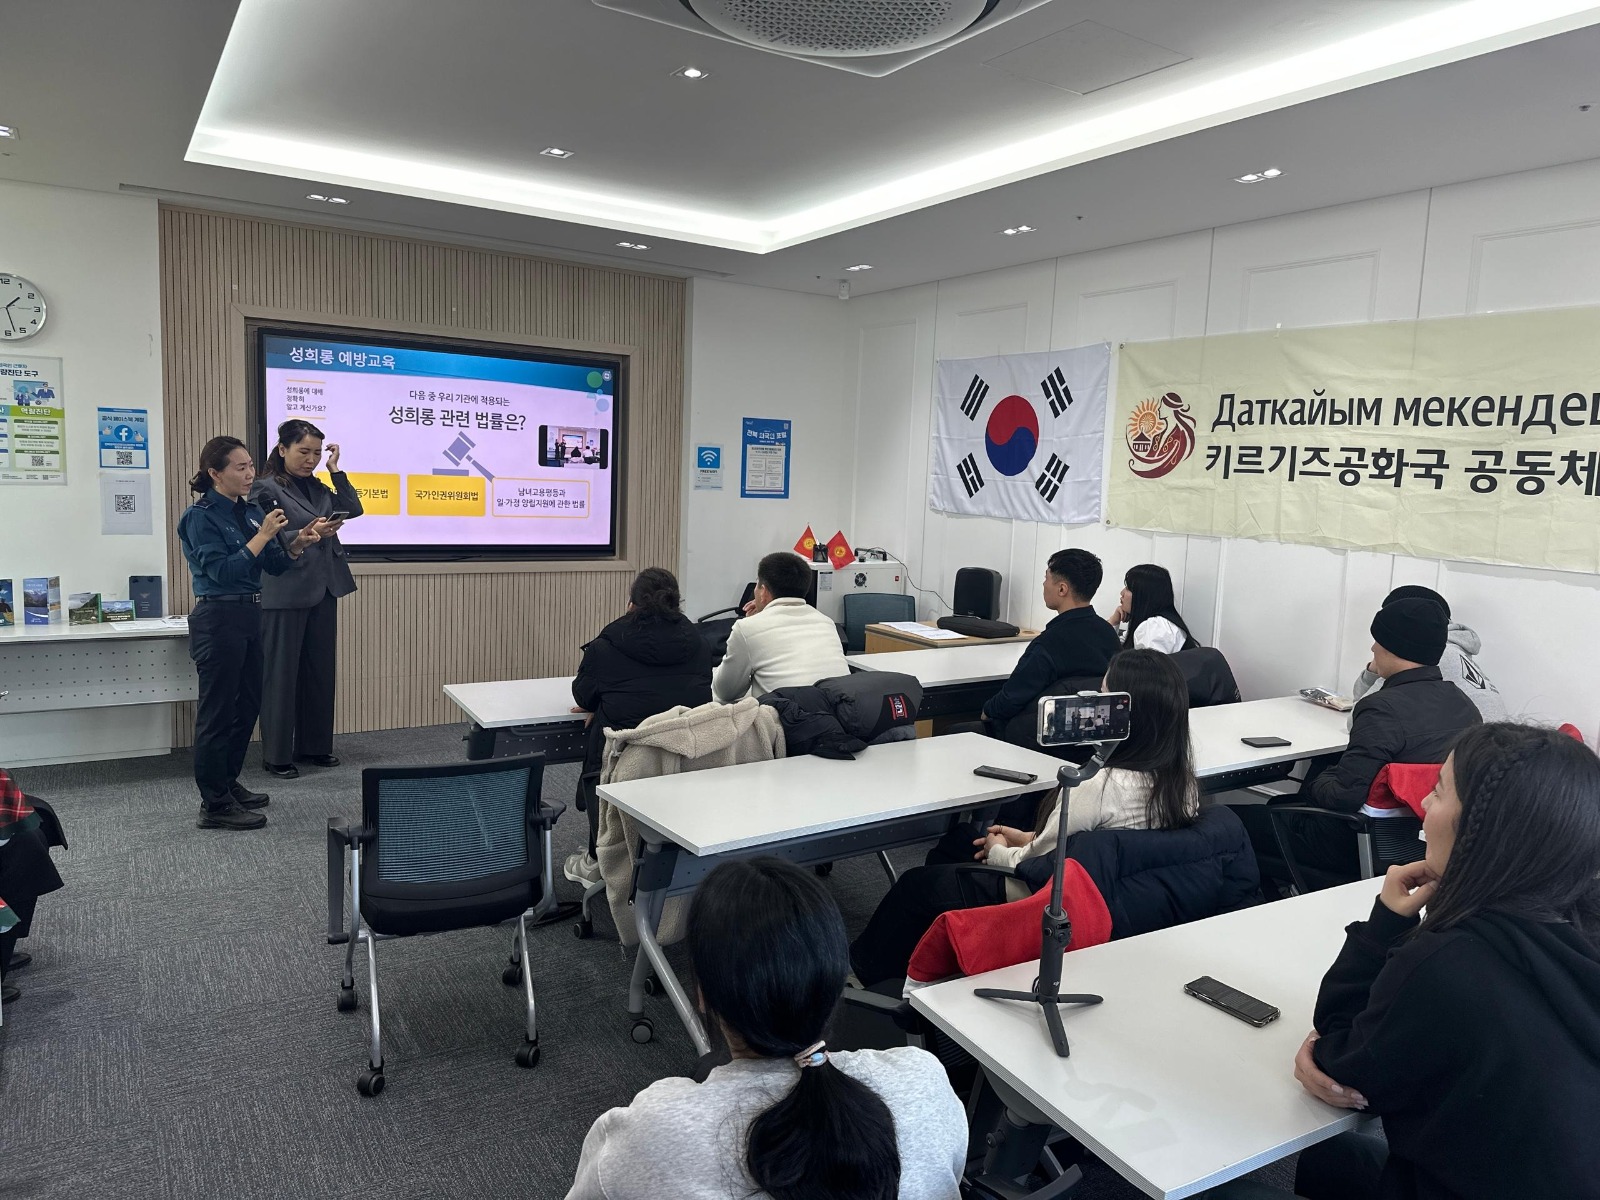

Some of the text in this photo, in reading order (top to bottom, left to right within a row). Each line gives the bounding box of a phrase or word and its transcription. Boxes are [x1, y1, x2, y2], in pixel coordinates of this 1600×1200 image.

[289, 347, 396, 370] 성희롱 예방교육
[286, 386, 310, 395] 성희롱에
[286, 395, 305, 403] 정확히
[409, 390, 511, 406] 다음 중 우리 기관에 적용되는
[286, 403, 326, 412] 알고 계신가요?
[1211, 389, 1381, 433] Даткайым
[388, 406, 527, 431] 성희롱 관련 법률은?
[1205, 444, 1600, 498] 키르기즈공화국 공동체
[415, 490, 479, 501] 국가인권위원회법
[518, 488, 566, 497] 남녀고용평등과
[557, 500, 571, 508] 관한
[572, 500, 585, 509] 법률
